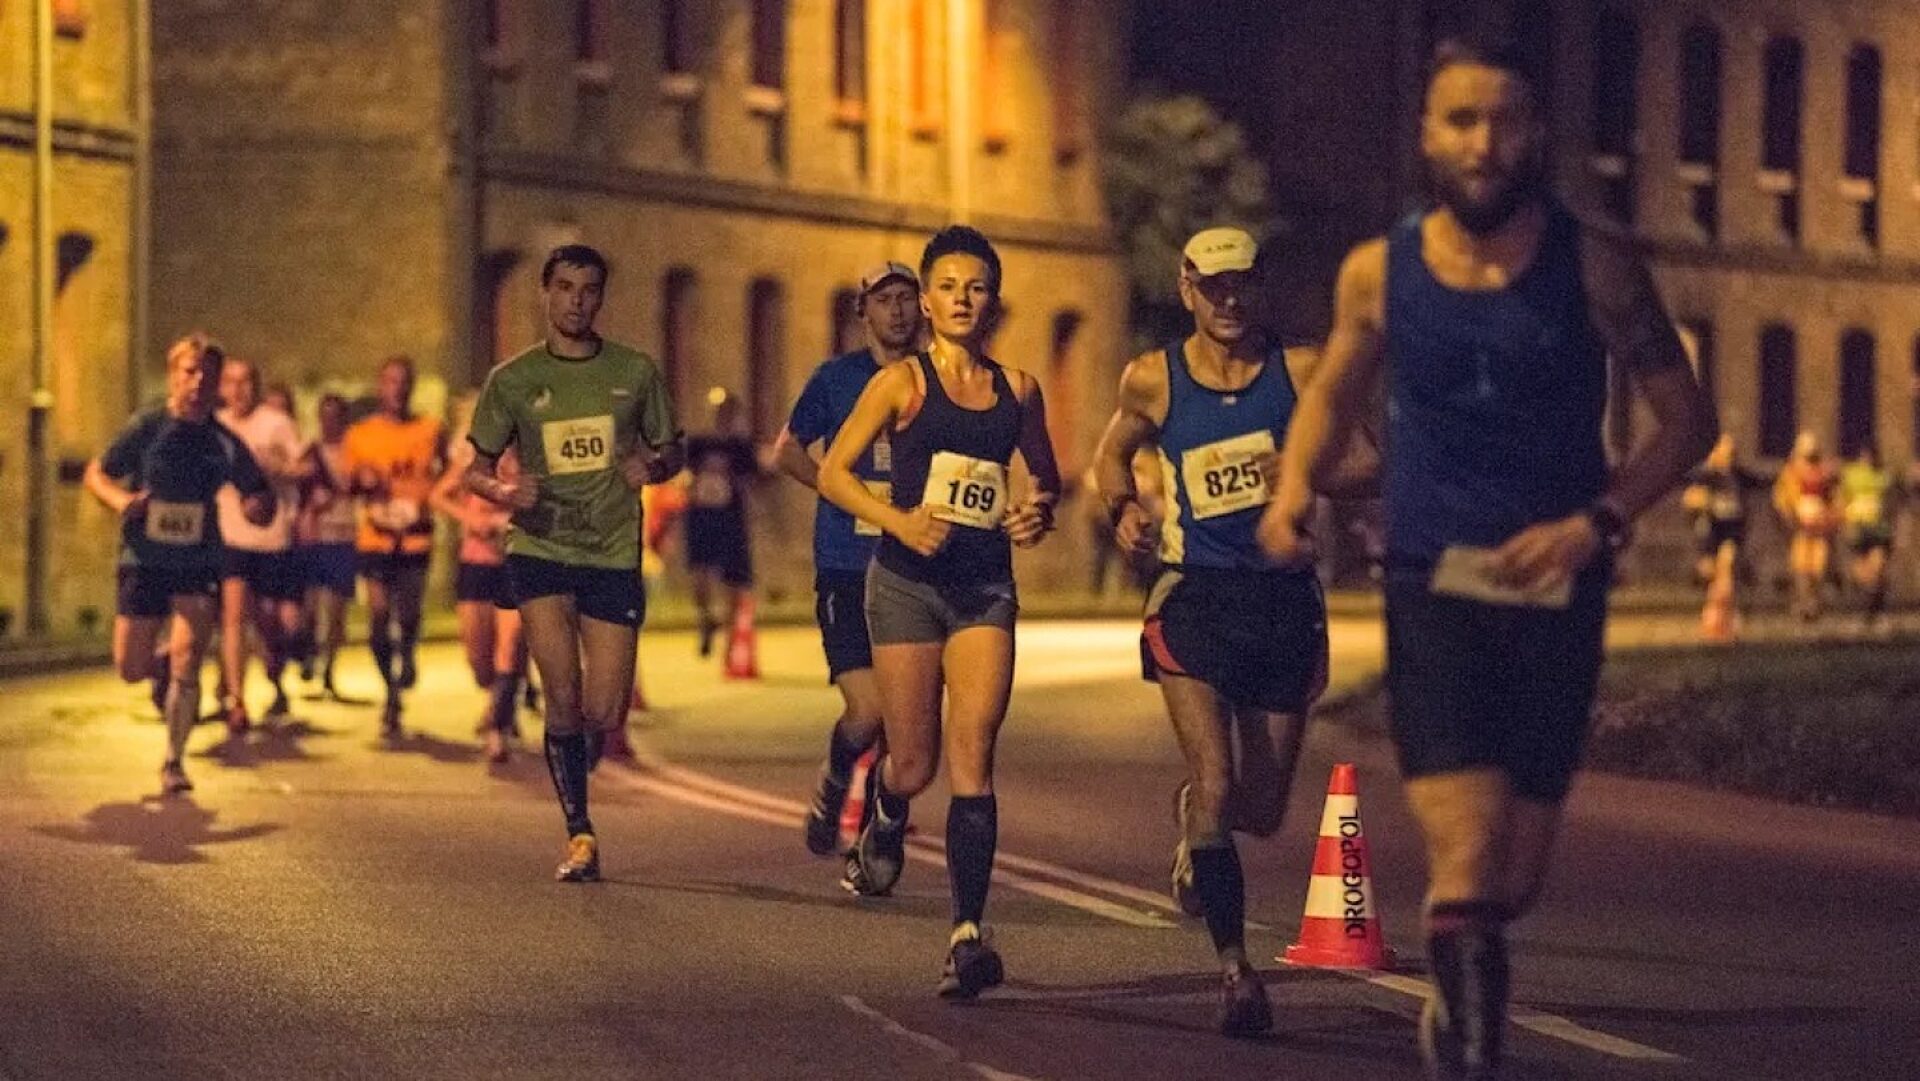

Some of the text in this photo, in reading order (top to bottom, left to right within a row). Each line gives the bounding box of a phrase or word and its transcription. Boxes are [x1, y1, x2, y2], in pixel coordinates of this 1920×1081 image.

[561, 436, 604, 460] 450
[948, 480, 996, 513] 169
[1204, 460, 1261, 498] 825
[1339, 807, 1366, 939] DROGOPOL
